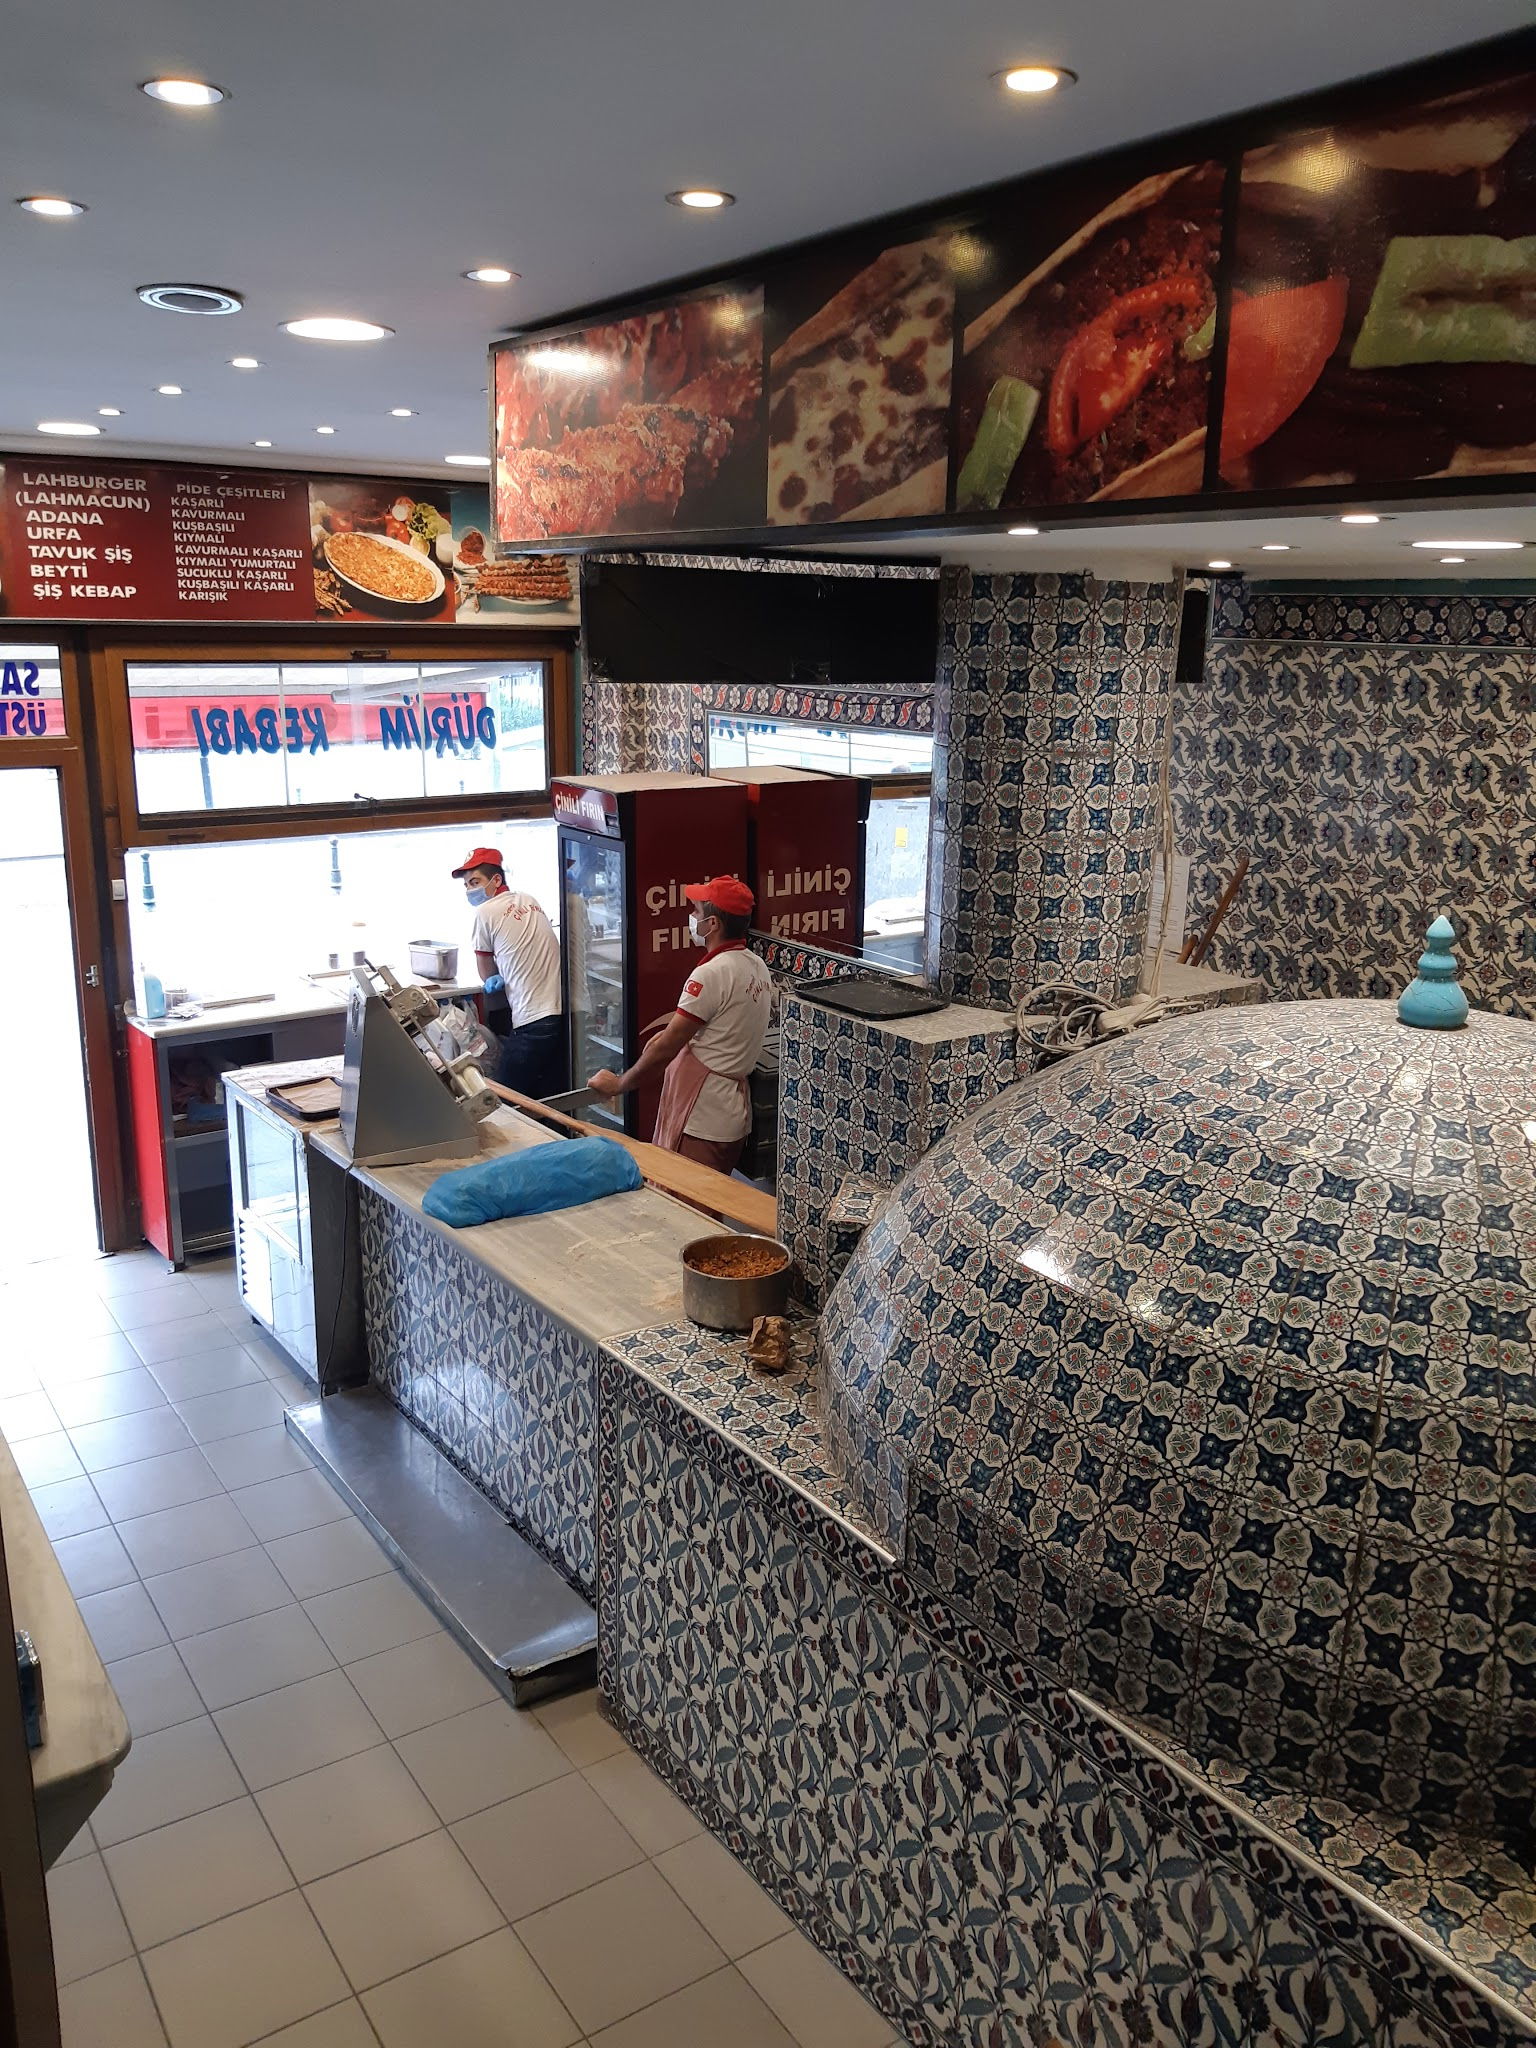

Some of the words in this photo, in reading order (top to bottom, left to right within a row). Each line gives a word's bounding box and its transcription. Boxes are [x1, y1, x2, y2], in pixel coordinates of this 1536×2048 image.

[22, 472, 148, 492] LAHBURGER
[176, 481, 211, 496] PİDE
[216, 485, 286, 500] ÇEŞİTLERİ
[15, 491, 151, 513] (LAHMACUN)
[170, 496, 224, 509] KAŞARLI
[26, 509, 104, 526] ADANA
[171, 509, 245, 521] KAVURMALI
[26, 526, 82, 541] URFA
[172, 520, 235, 534] KUŞBAŞILI
[173, 532, 225, 544] KIYMALI
[28, 545, 98, 560] TAVUK
[104, 544, 133, 565] ŞİŞ
[174, 544, 248, 556] KAVURMALI
[252, 548, 303, 560] KAŞARLI
[30, 562, 89, 579] BEYTİ
[175, 556, 226, 568] KIYMALI
[230, 558, 296, 570] YUMURTALI
[176, 568, 232, 579] SUCUKLU
[236, 570, 287, 581] KAŞARLI
[33, 580, 63, 601] ŞİŞ
[70, 584, 137, 599] KEBAP
[177, 579, 240, 592] KUŞBAŞILI
[244, 581, 294, 593] KAŞARLI
[178, 591, 229, 604] KARIŞIK
[555, 791, 580, 816] ÇİNİLİ
[581, 800, 605, 822] FIRIN
